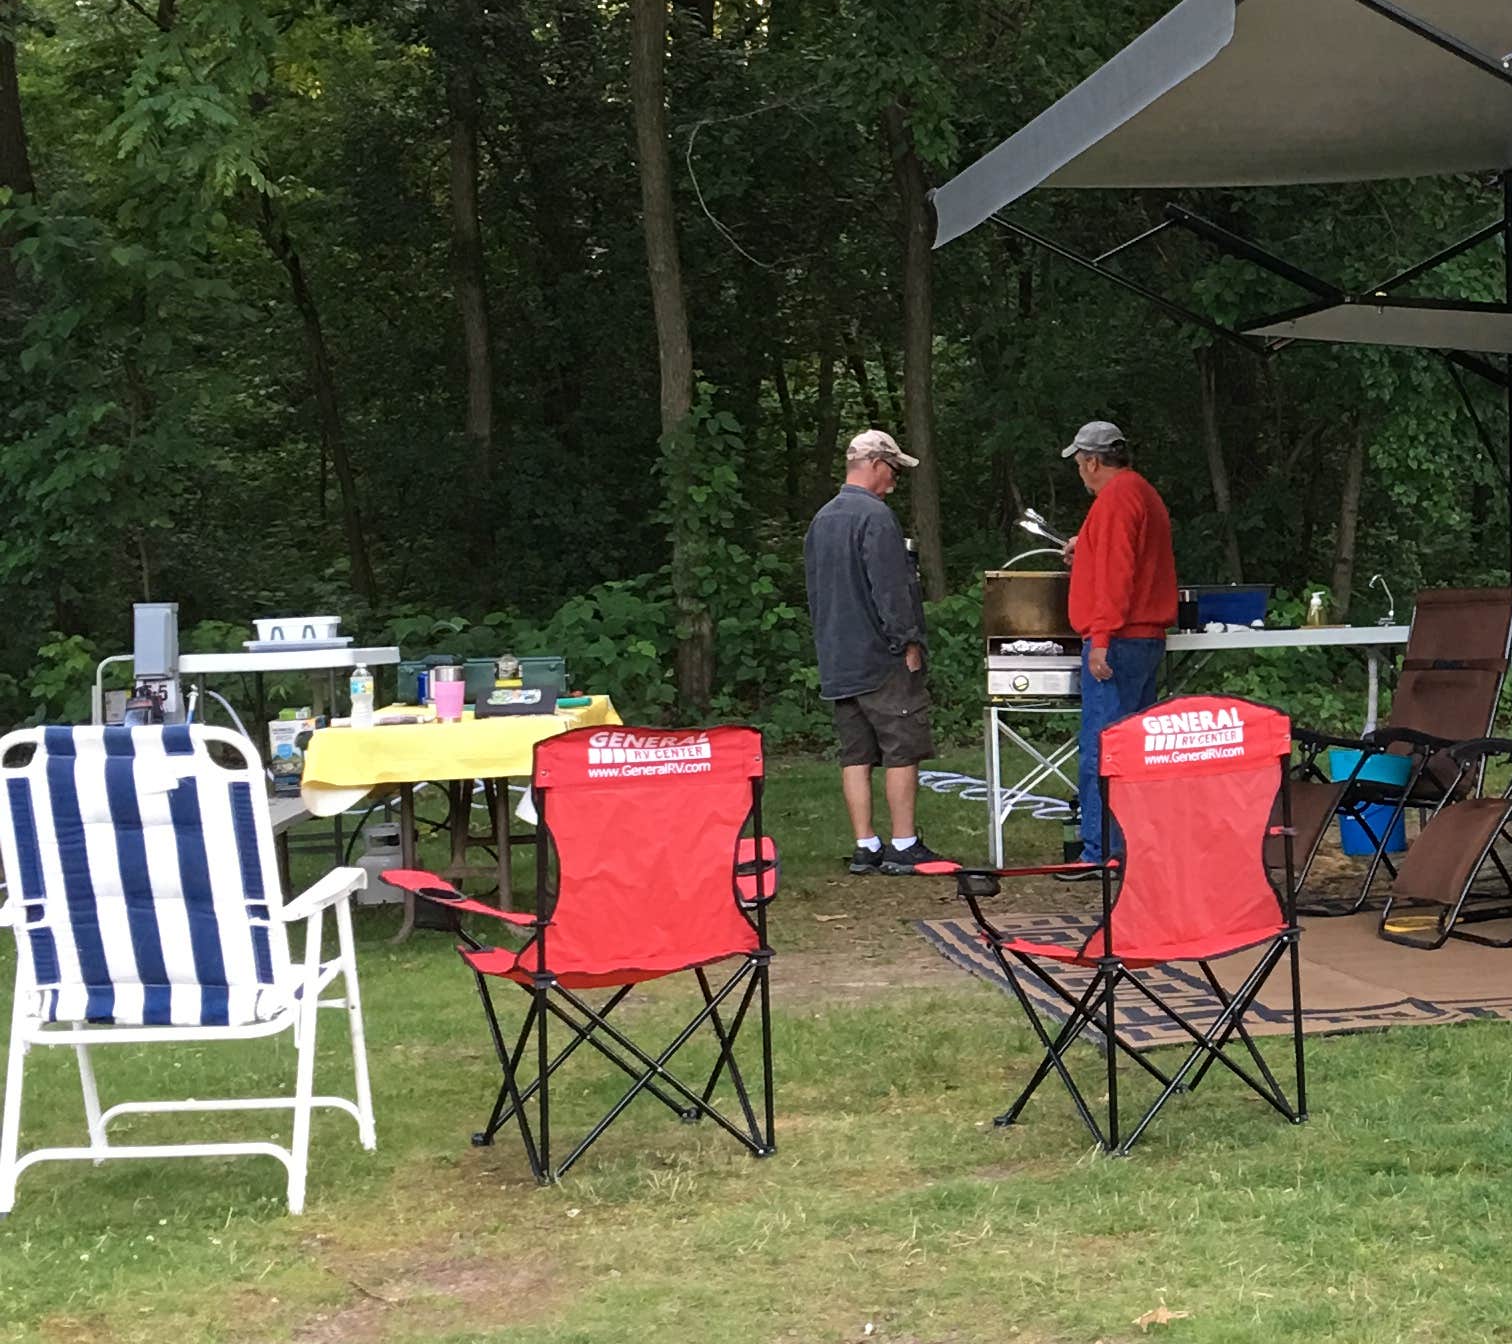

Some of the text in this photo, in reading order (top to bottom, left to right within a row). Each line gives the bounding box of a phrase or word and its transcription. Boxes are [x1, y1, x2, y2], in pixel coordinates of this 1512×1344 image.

[1142, 707, 1245, 735] GENERAL
[588, 732, 710, 748] GENERAL
[1181, 730, 1237, 746] RV CENTER
[634, 746, 703, 760] RV CENTER
[1144, 746, 1245, 765] www.GeneralRV.com
[587, 762, 711, 778] www.GeneralRV.com
